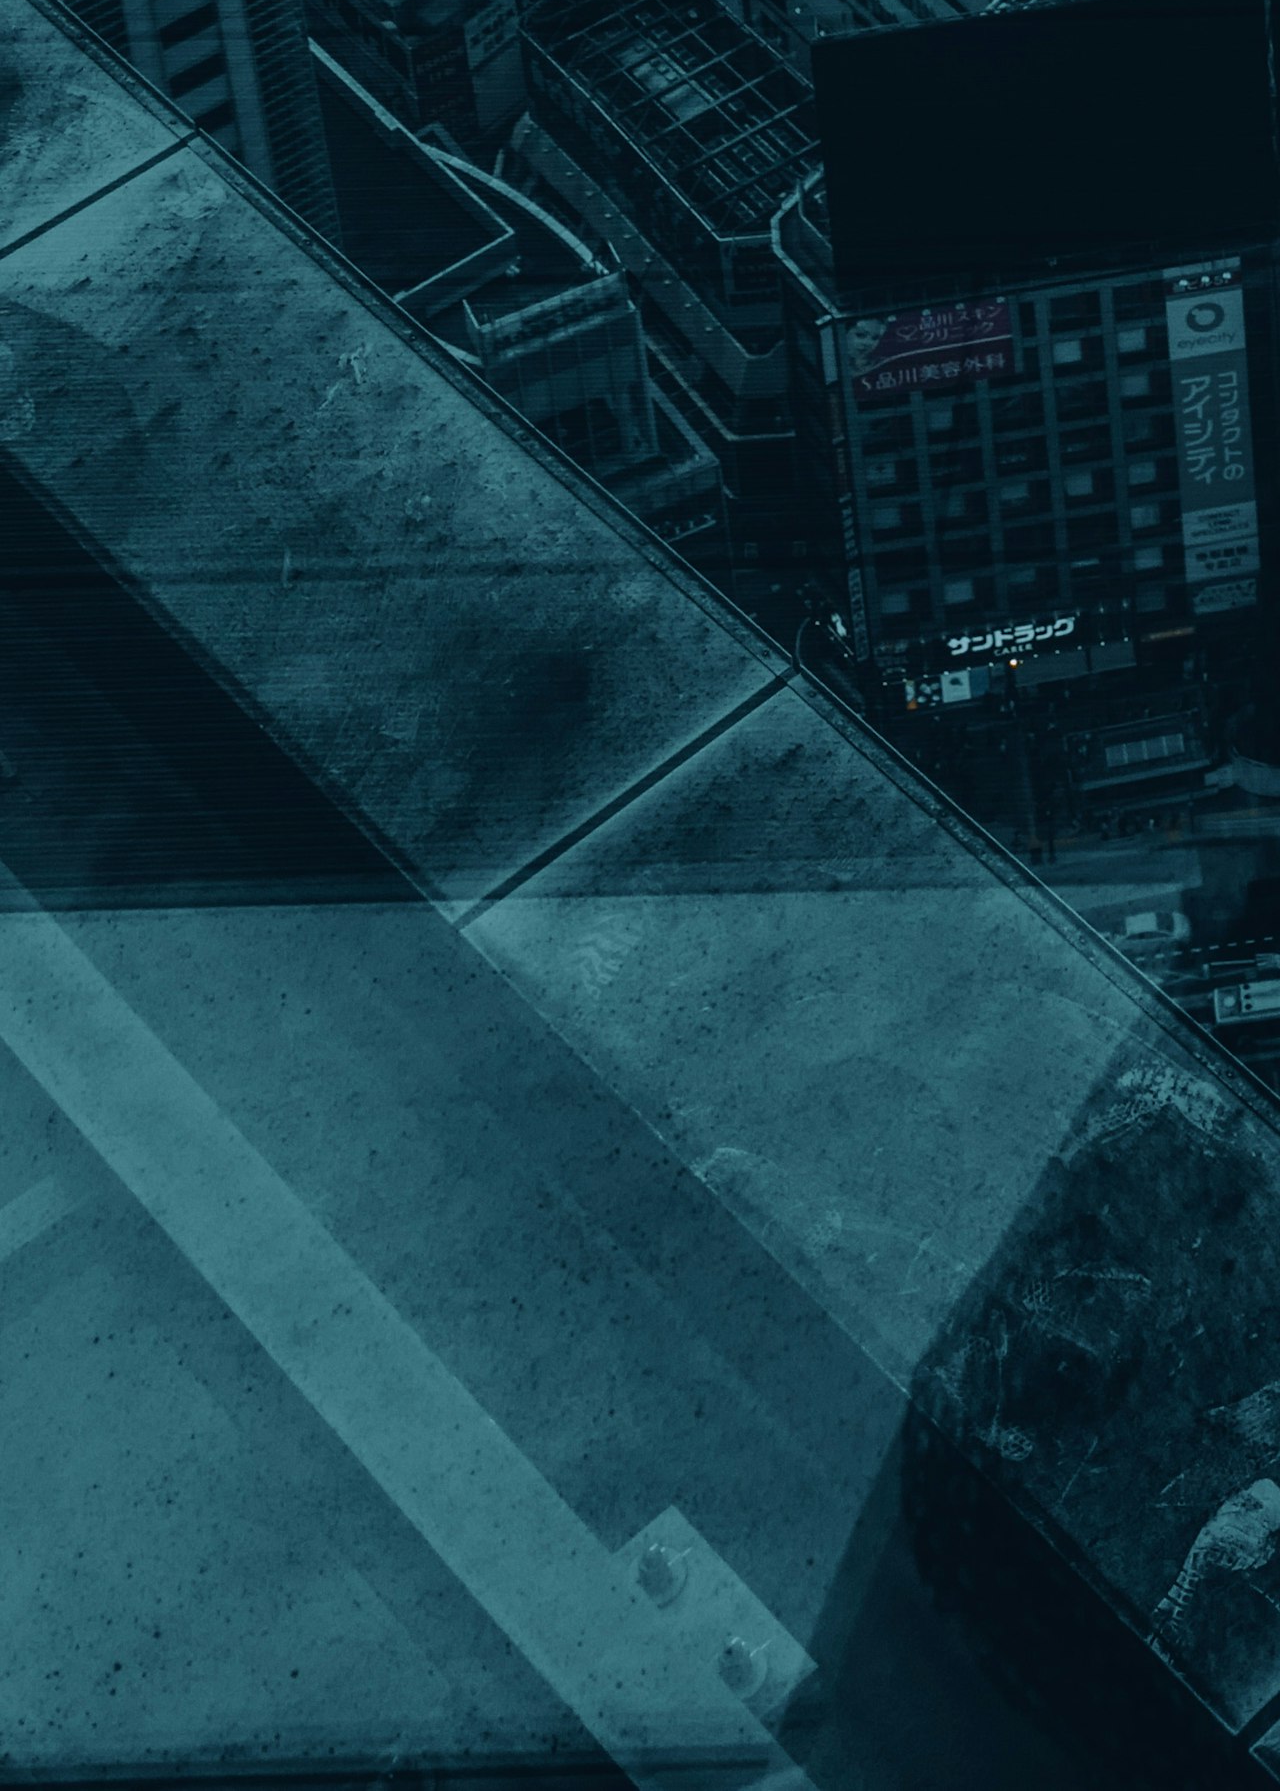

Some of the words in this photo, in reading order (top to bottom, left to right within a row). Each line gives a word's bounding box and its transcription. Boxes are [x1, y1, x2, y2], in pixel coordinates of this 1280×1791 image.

[1179, 374, 1217, 486] アイシティ
[1217, 371, 1245, 482] コンタクトの
[949, 619, 1077, 657] サンドラッグ
